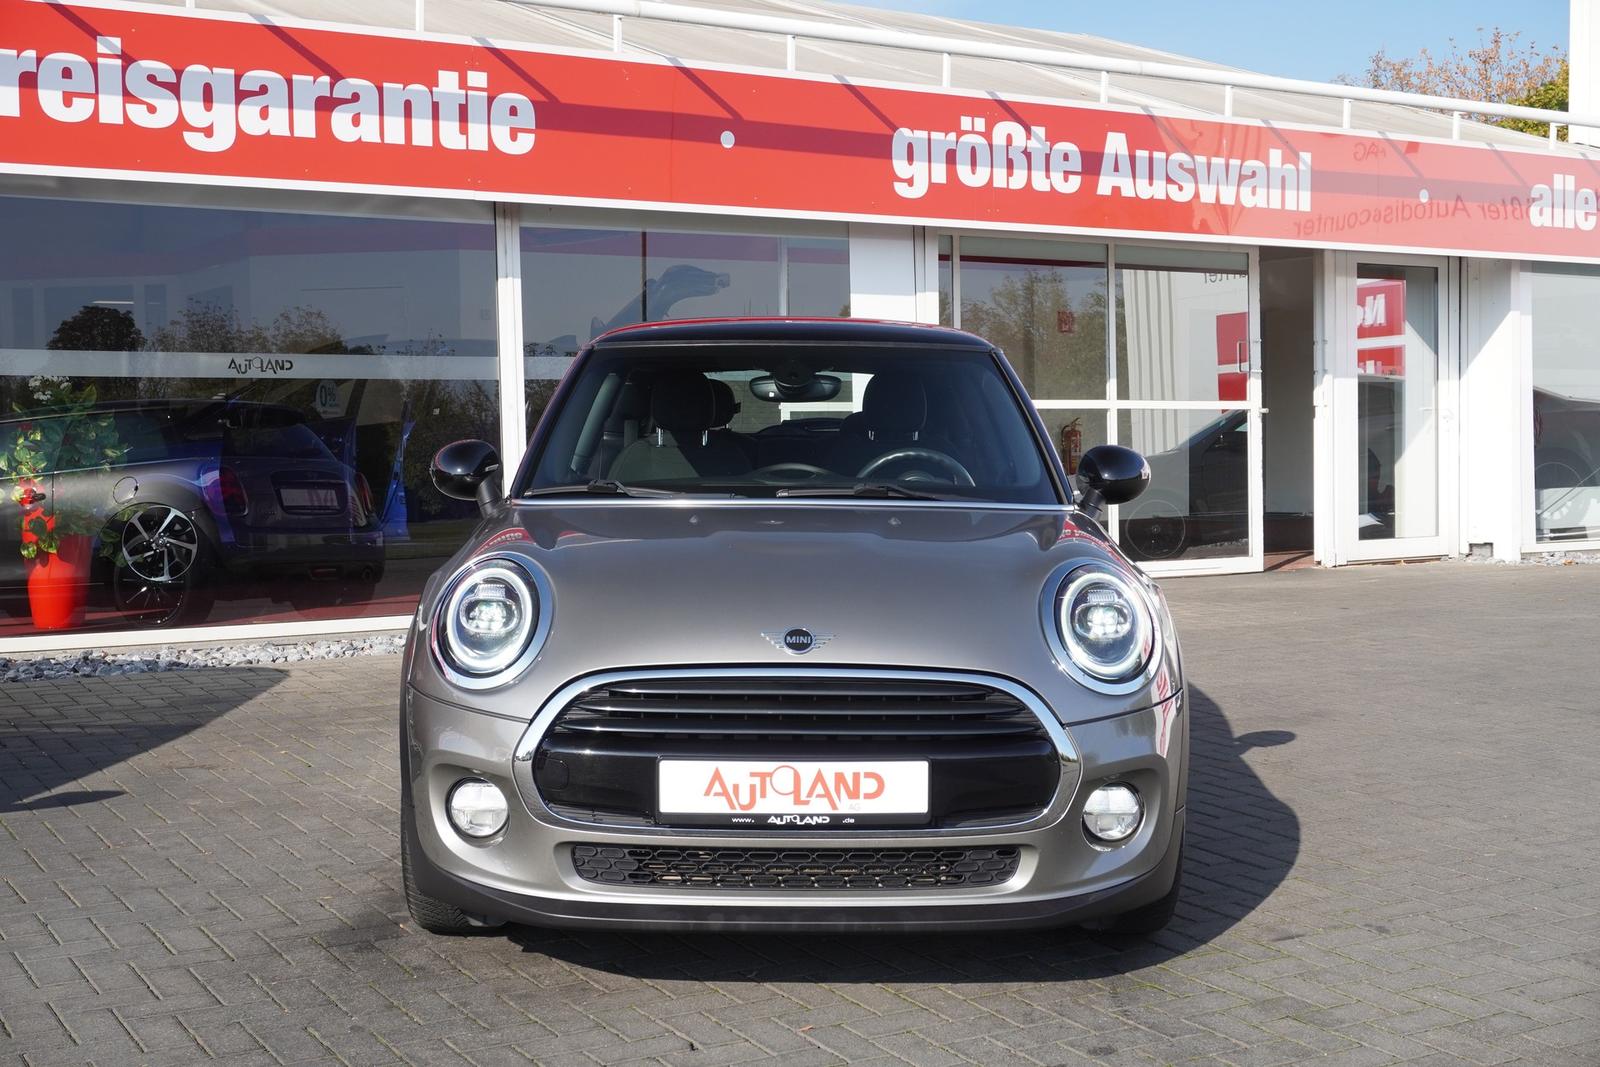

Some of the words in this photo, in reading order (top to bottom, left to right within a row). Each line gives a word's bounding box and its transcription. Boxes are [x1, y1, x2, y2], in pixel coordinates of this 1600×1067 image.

[0, 36, 536, 154] reisgarantie
[891, 116, 1082, 199] größte
[1096, 131, 1312, 212] Auswahl
[1529, 173, 1597, 231] alle
[786, 635, 811, 644] MINI
[703, 764, 886, 811] AUTOLAND
[767, 814, 831, 826] AUTOLAND
